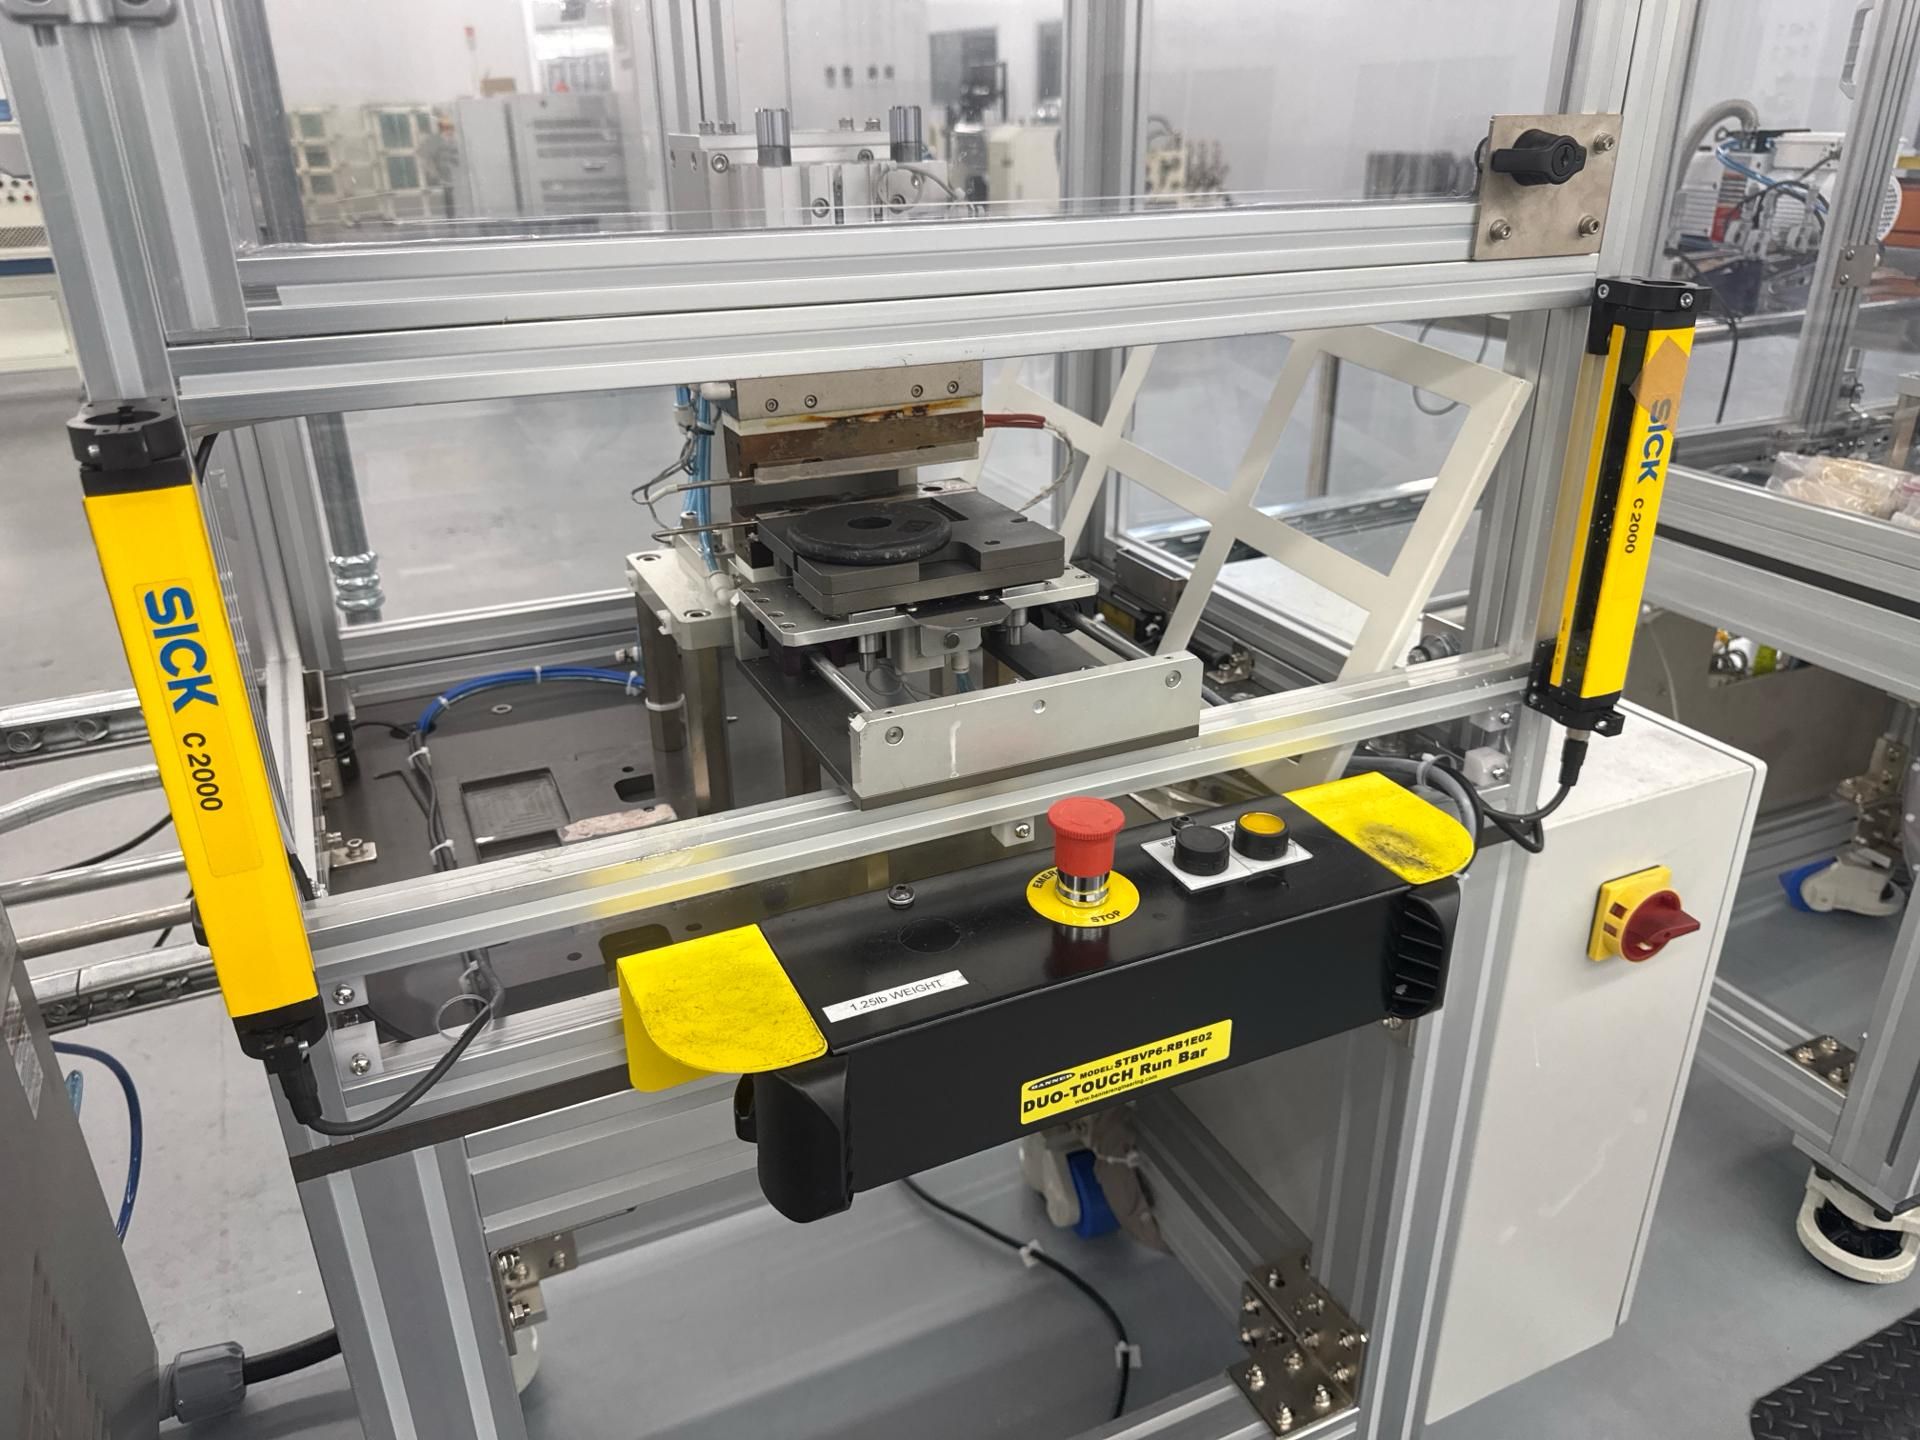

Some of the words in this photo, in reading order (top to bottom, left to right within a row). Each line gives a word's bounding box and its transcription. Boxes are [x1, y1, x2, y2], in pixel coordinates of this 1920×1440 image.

[1637, 398, 1671, 484] SICK
[1633, 498, 1644, 509] C
[1624, 513, 1641, 554] 2000
[144, 587, 219, 714] SICK
[182, 732, 206, 748] C
[187, 753, 223, 811] 2000
[1033, 869, 1058, 888] EMER
[1091, 910, 1120, 923] STOP
[850, 996, 888, 1011] 1.25lb
[889, 979, 943, 1000] WEIGHT
[1079, 1064, 1114, 1080] MODEL:
[1114, 1031, 1213, 1068] STBVP6-RB1E02
[1023, 1068, 1134, 1113] DUO-TOUCH
[1139, 1057, 1173, 1076] Run
[1178, 1046, 1208, 1064] Bar
[1031, 1073, 1074, 1090] BANNER
